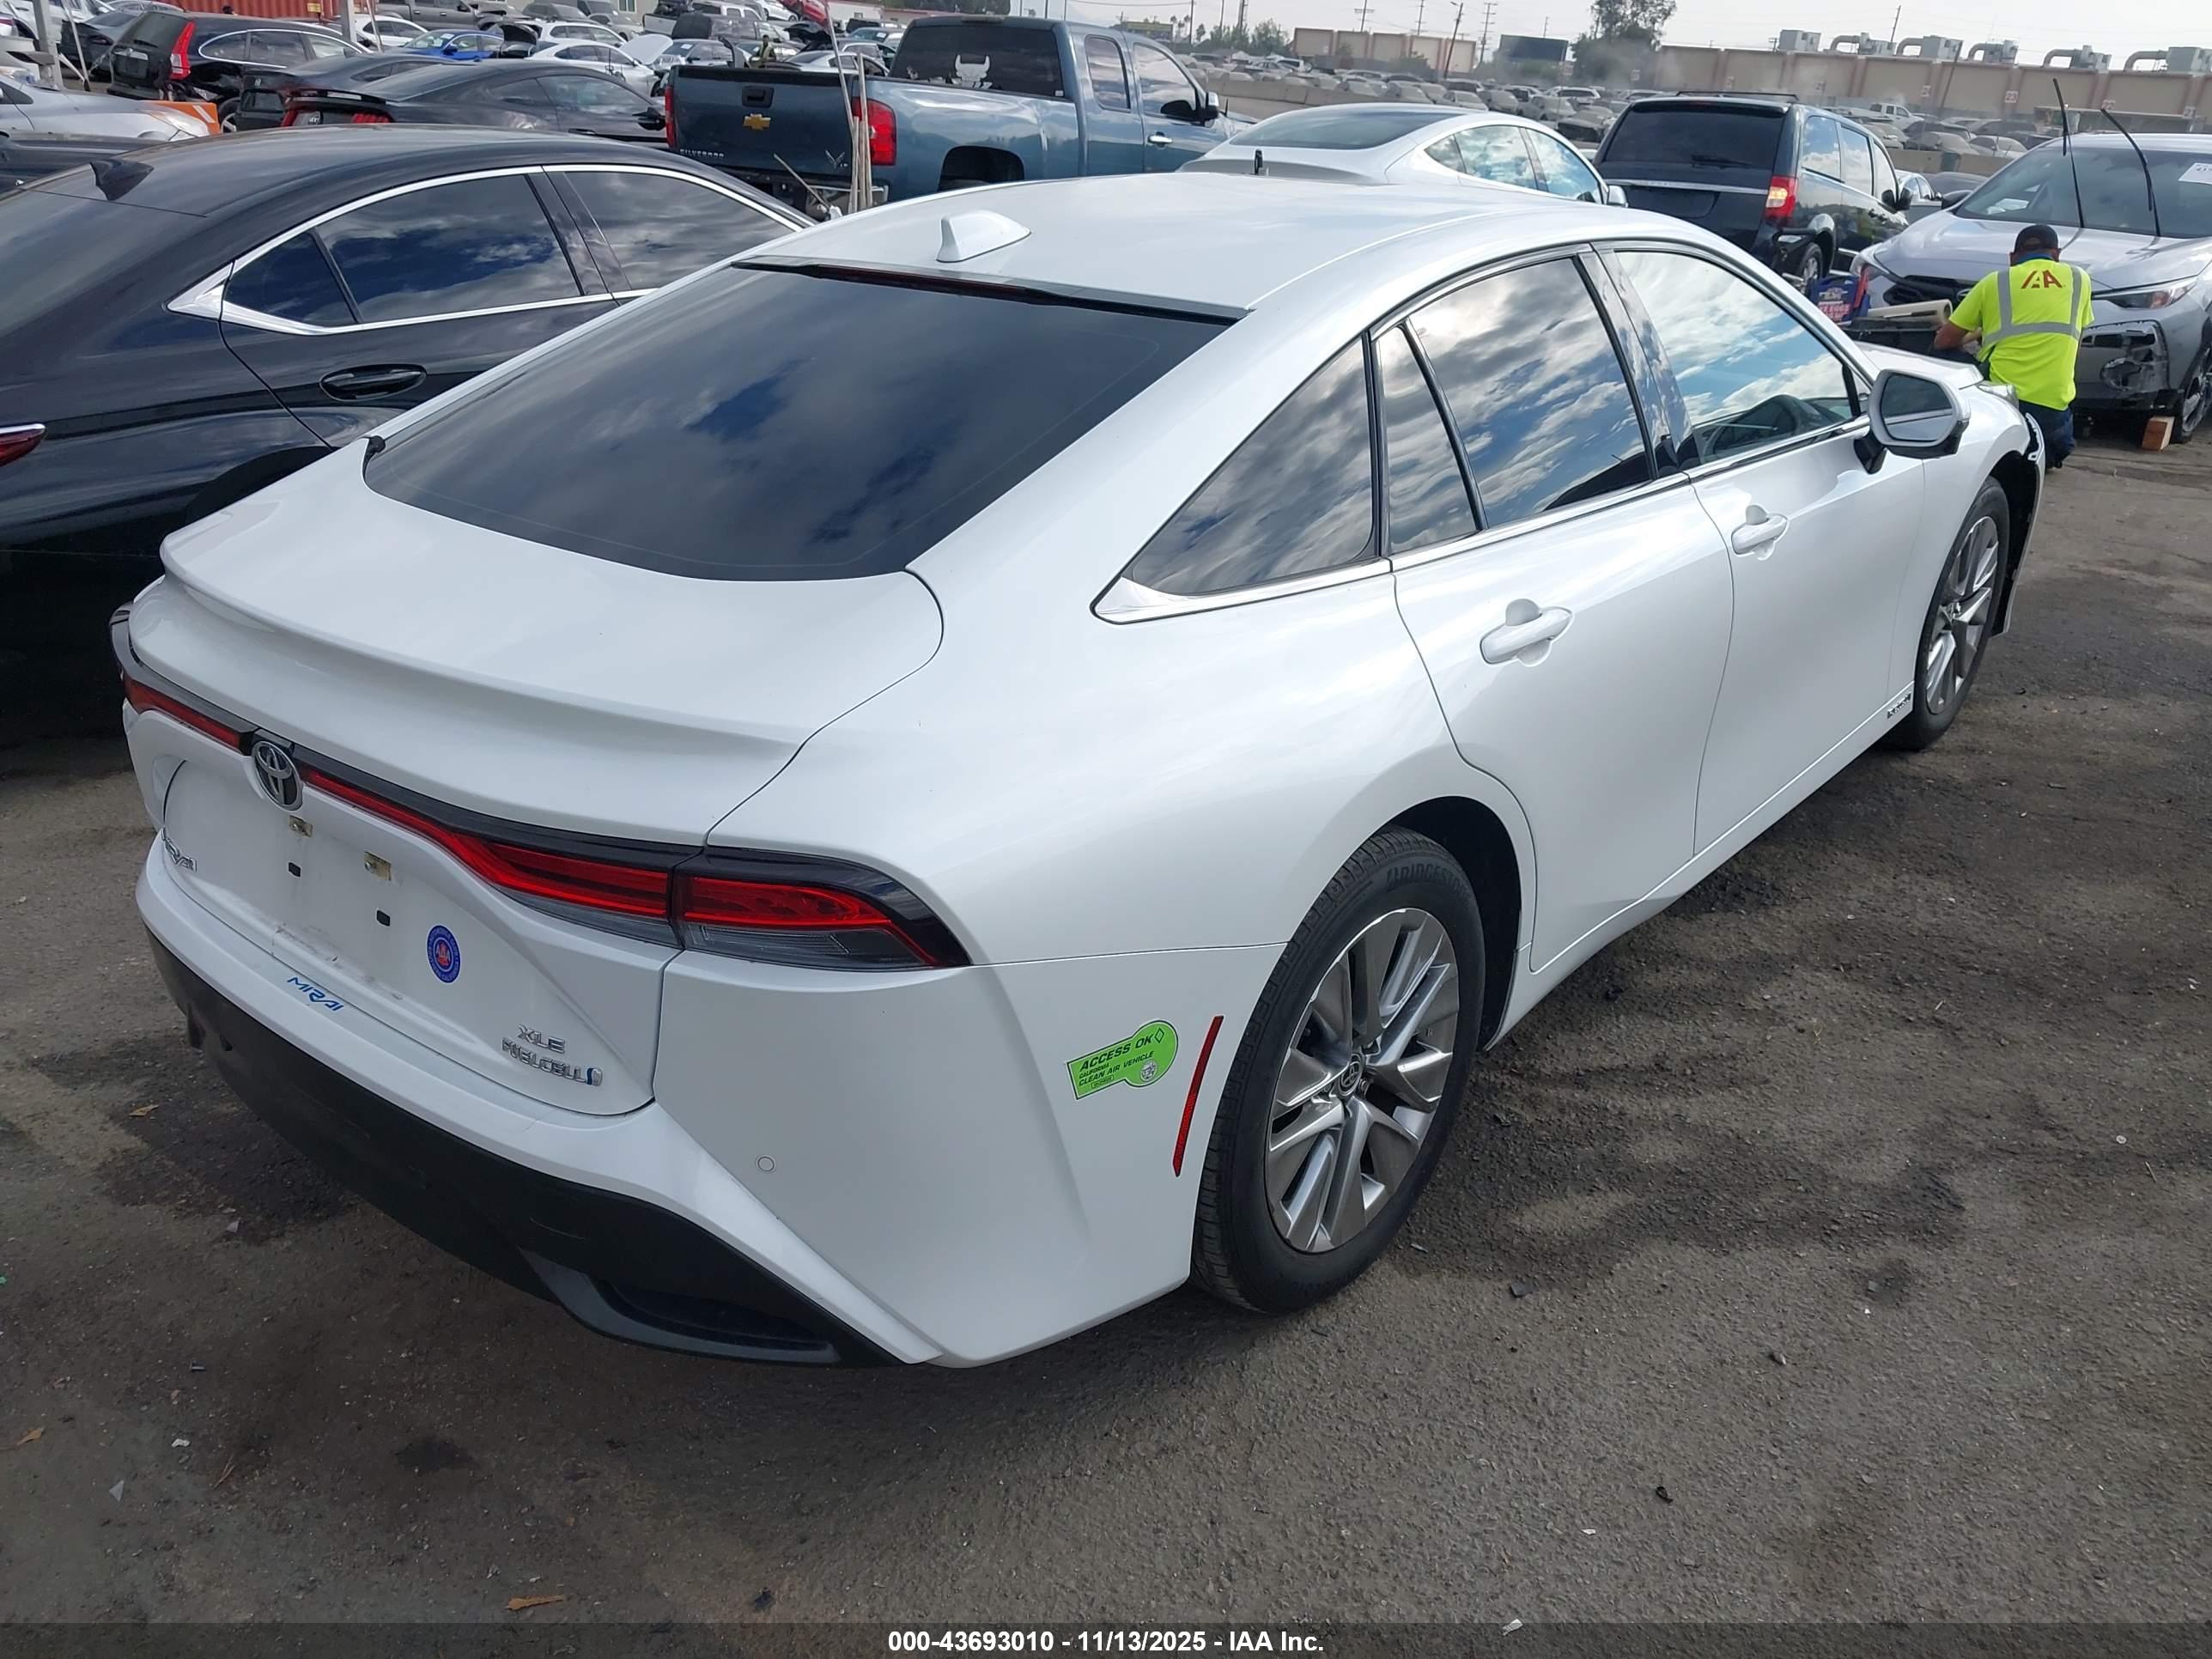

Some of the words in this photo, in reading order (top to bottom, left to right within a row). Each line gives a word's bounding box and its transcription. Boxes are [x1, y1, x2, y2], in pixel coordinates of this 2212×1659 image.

[287, 976, 344, 1012] MIRAI
[517, 1024, 566, 1054] XLE
[1079, 1042, 1132, 1073] ACCESS
[1134, 1033, 1154, 1049] OK
[1079, 1070, 1105, 1087] CLEAN
[1107, 1064, 1121, 1075] AIR
[1123, 1050, 1155, 1068] VEHICLE
